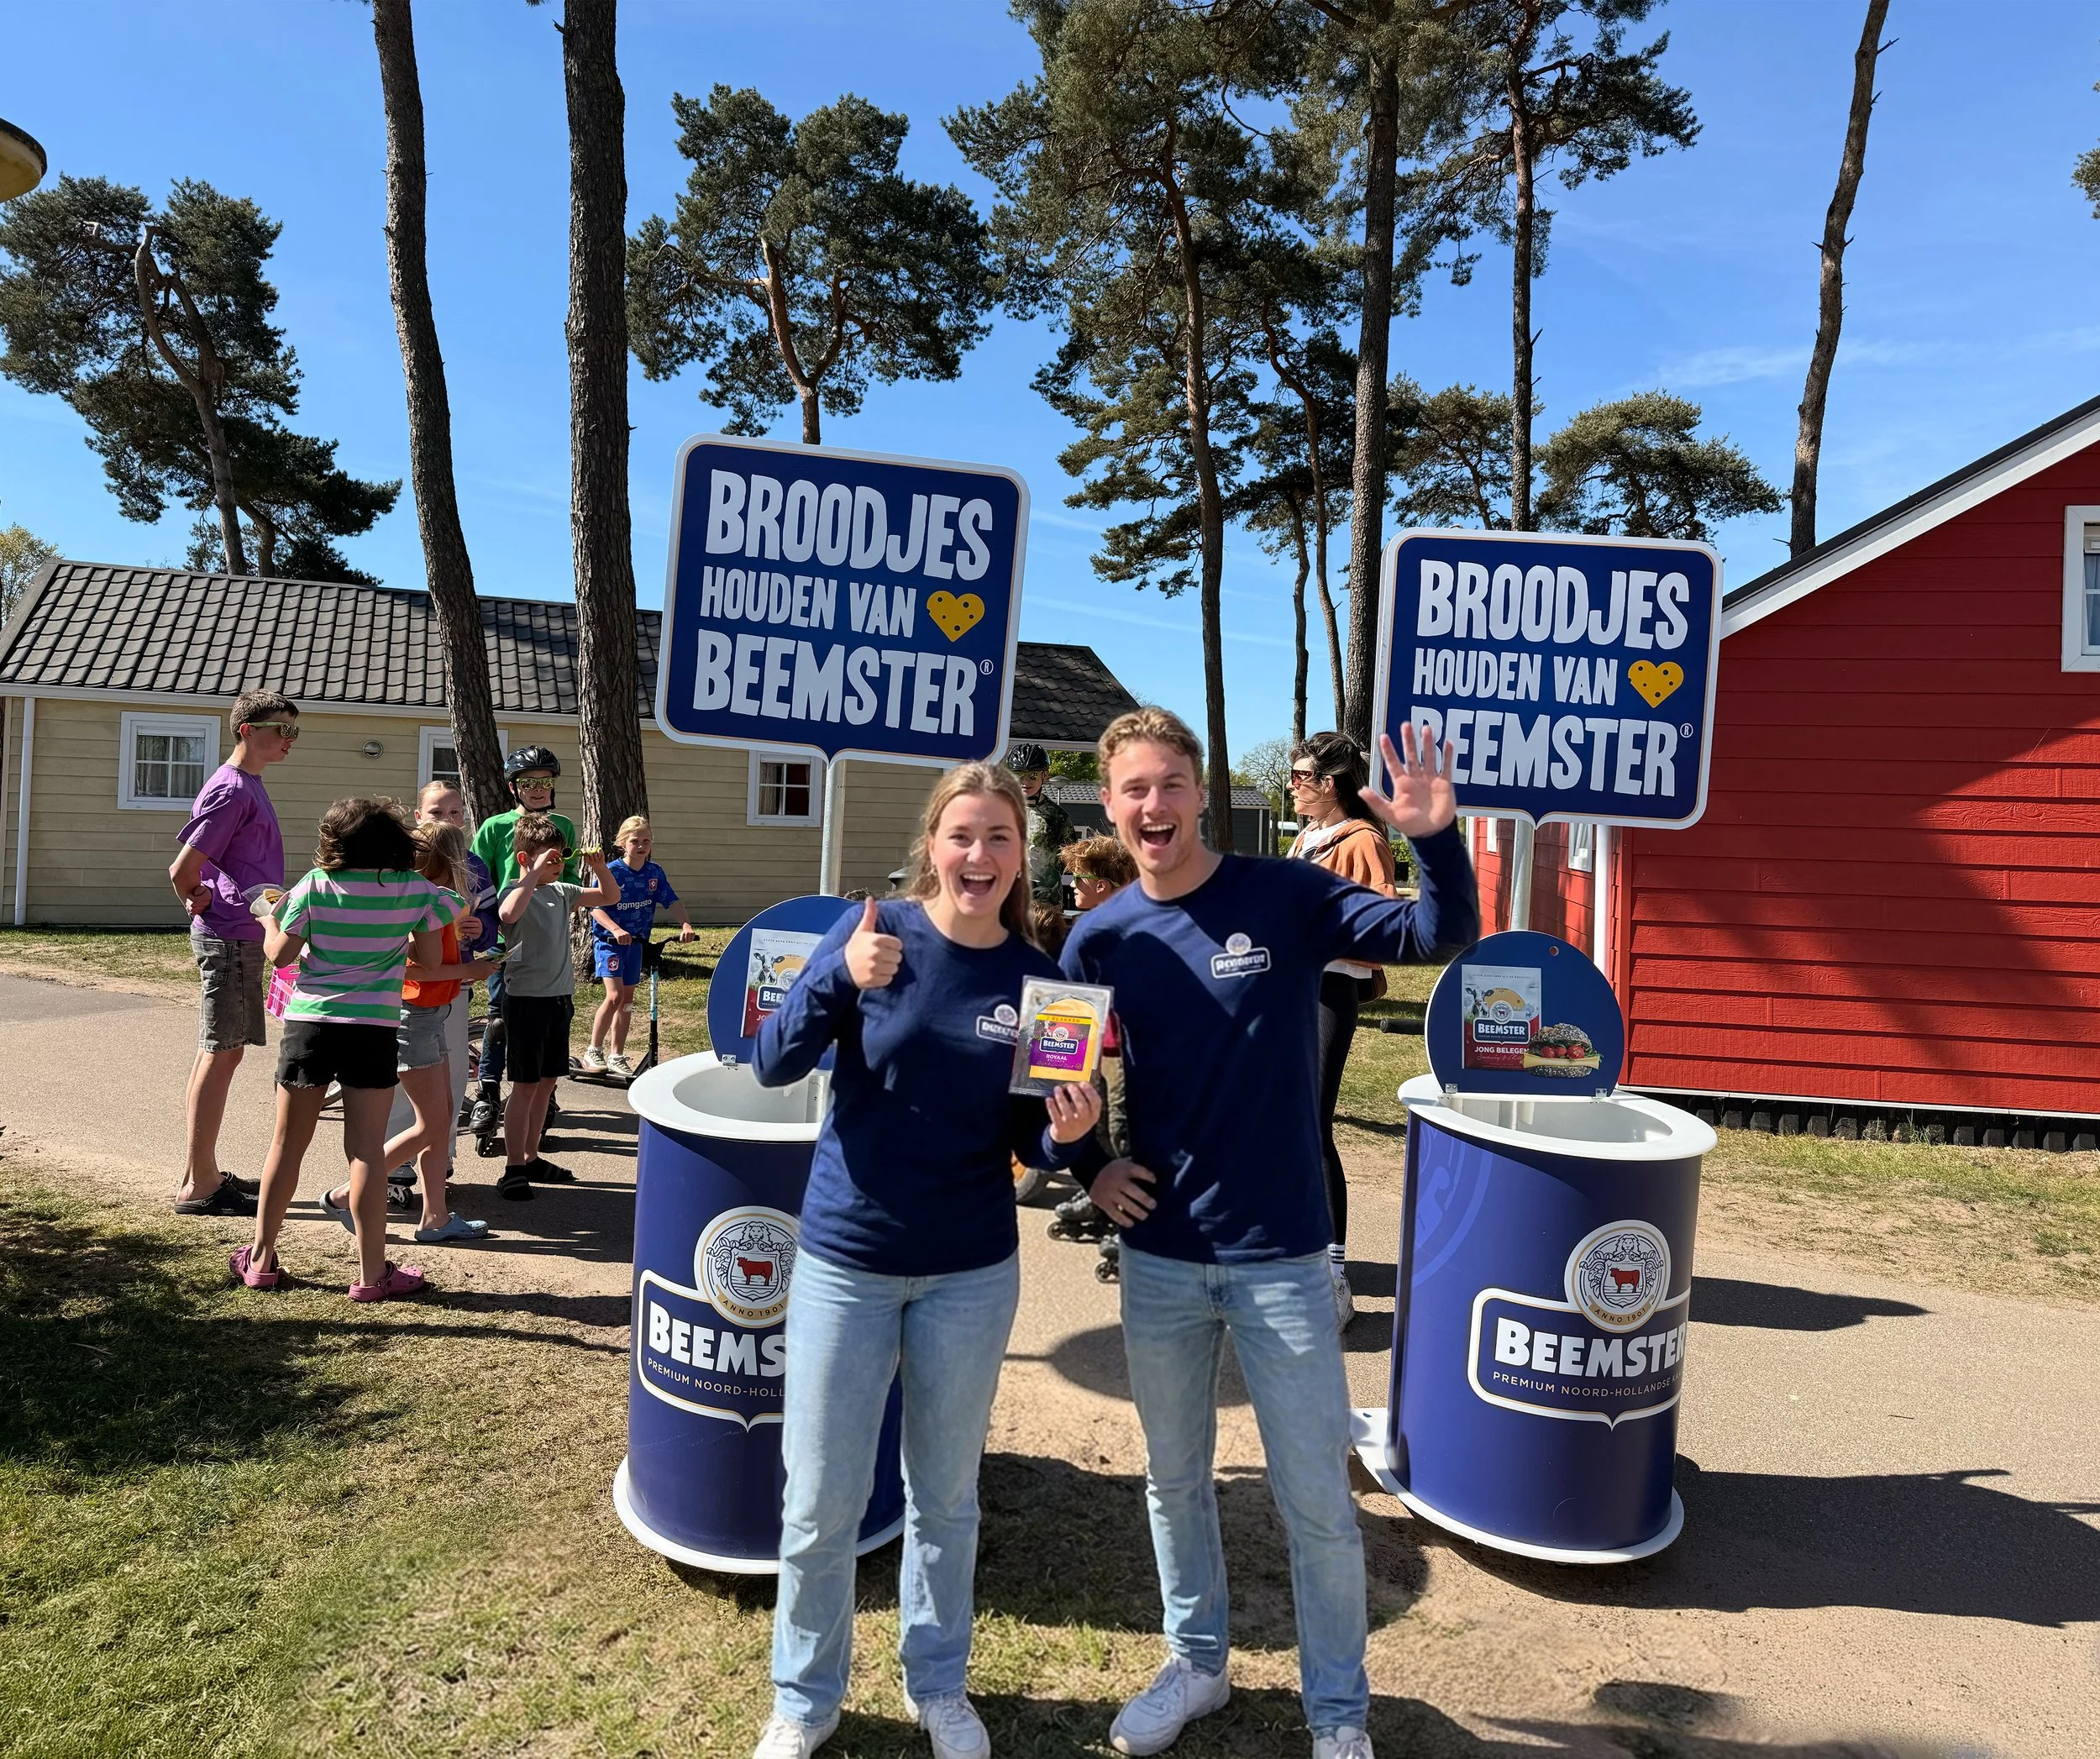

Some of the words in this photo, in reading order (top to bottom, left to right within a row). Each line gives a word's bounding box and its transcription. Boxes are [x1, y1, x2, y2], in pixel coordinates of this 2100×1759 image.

[706, 469, 993, 580] BROODJES
[700, 566, 837, 630] HOUDEN
[850, 582, 916, 638] VAN
[1417, 559, 1689, 649] BROODJES
[1412, 648, 1542, 701] HOUDEN
[1554, 656, 1618, 706] VAN
[1042, 1040, 1075, 1049] BEEMSTER
[1478, 1023, 1525, 1035] BEEMSTER
[722, 1300, 754, 1318] ANNO
[759, 1303, 785, 1317] 1901
[1594, 1307, 1623, 1323] ANNO
[1626, 1307, 1647, 1322] 1901
[648, 1300, 787, 1378] BEEMS
[648, 1357, 690, 1385] PREMIUM
[695, 1379, 786, 1398] NOORD-HOLL
[1493, 1371, 1555, 1394] PREMIUM
[1562, 1376, 1670, 1397] NOORD-HOLLANDSE
